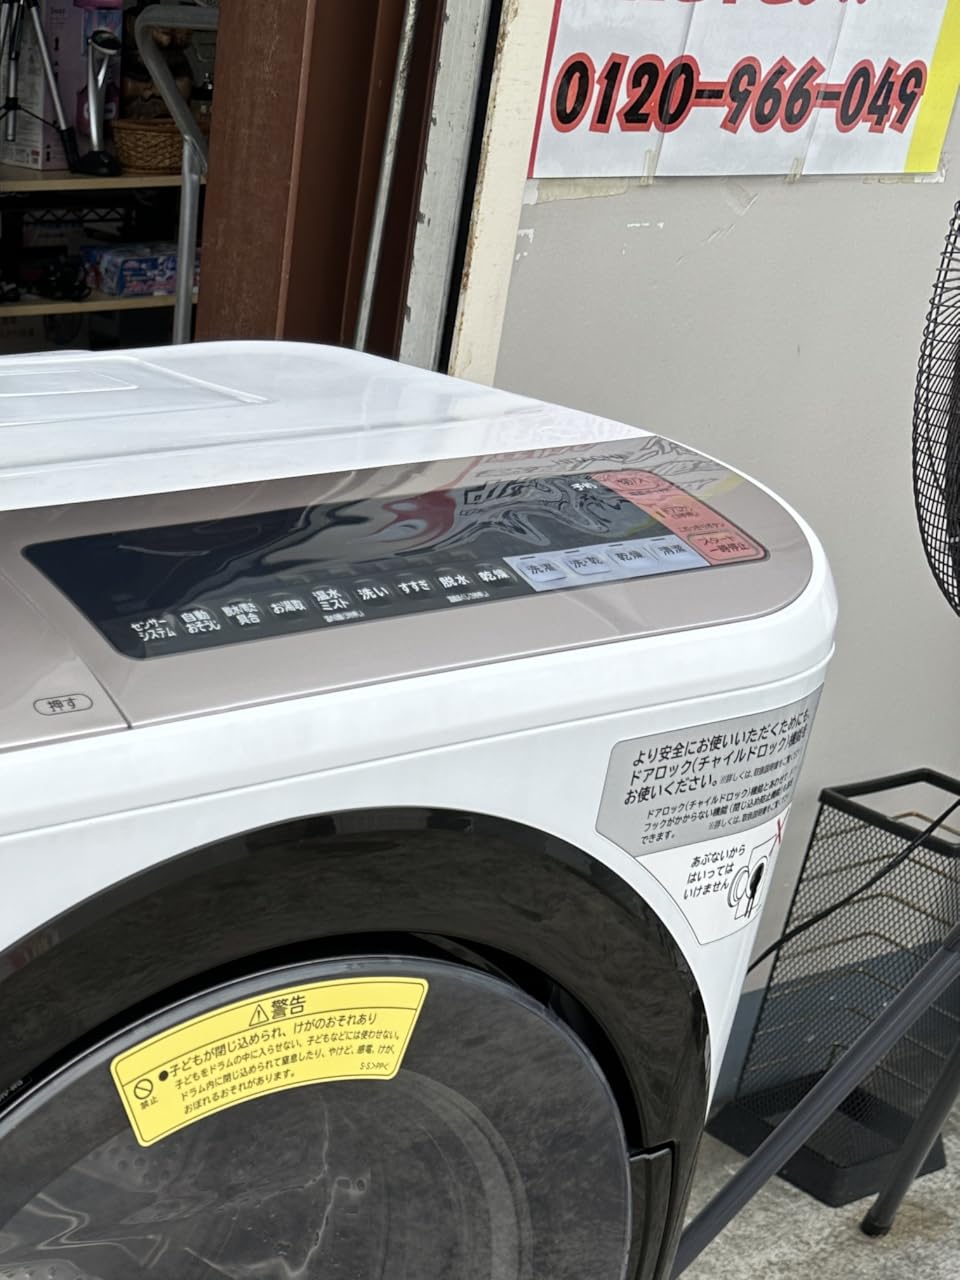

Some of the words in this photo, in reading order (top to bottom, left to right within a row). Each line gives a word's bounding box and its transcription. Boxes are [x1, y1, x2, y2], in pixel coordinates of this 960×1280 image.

[551, 52, 928, 133] 0120-966-049
[439, 574, 471, 588] 脱水
[478, 568, 510, 583] 乾燥
[357, 586, 390, 600] 洗い
[398, 579, 432, 594] すすぎ
[320, 598, 350, 611] ミスト
[180, 610, 211, 623] 自動
[130, 617, 168, 632] センサー
[186, 619, 221, 634] おそうじ
[138, 628, 177, 642] システム
[47, 697, 76, 712] 押す
[632, 709, 810, 767] より安全にお使いいただくためにも
[624, 774, 718, 805] お使いください。
[640, 829, 676, 846] できます。
[691, 844, 746, 868] あぶないから
[687, 862, 735, 885] はいっては
[683, 878, 730, 900] いけません
[271, 995, 307, 1021] 警告
[183, 1067, 295, 1116] おぼれるおそれがあります。
[140, 1096, 159, 1110] 禁止
